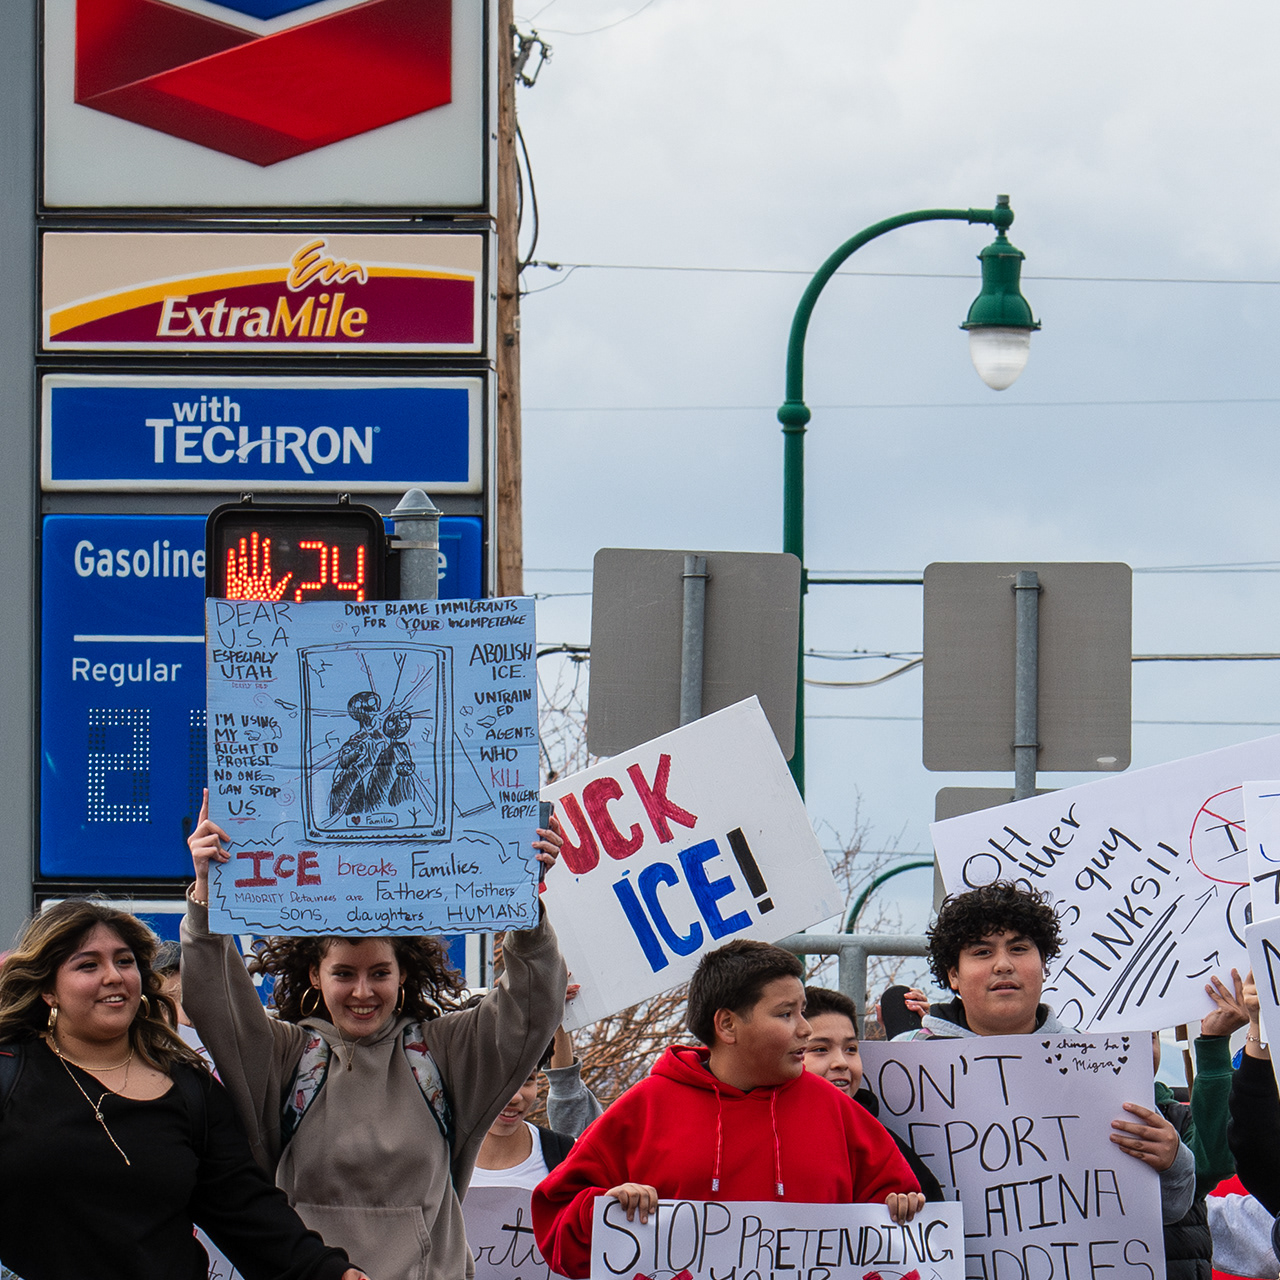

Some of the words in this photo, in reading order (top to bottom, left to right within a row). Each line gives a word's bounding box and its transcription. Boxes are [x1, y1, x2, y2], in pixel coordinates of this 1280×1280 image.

[289, 239, 368, 290] Em
[156, 293, 368, 338] ExtraMile
[172, 396, 240, 423] with
[74, 540, 206, 577] Gasoline
[295, 541, 364, 602] 24
[215, 602, 293, 627] DEAR
[345, 603, 378, 616] DONT
[385, 603, 429, 616] BLAME
[435, 600, 518, 614] IMMIGRANTS
[364, 617, 387, 628] FOR
[401, 618, 440, 630] YOUR
[217, 627, 290, 649] U.S.A
[469, 642, 532, 666] ABOLISH
[72, 658, 182, 687] Regular
[221, 665, 272, 680] UTAH
[492, 664, 526, 681] ICE.
[474, 688, 532, 705] UNTRAIN
[215, 713, 235, 727] I'M
[241, 715, 278, 728] USING
[496, 705, 514, 717] ED
[214, 728, 238, 742] MY
[215, 743, 259, 755] RIGHT
[264, 742, 278, 753] TO
[480, 746, 518, 763] WHO
[214, 770, 232, 782] NO
[238, 770, 262, 781] ONE
[491, 767, 525, 788] KILL
[218, 784, 241, 795] CAN
[249, 785, 281, 798] STOP
[365, 816, 394, 825] Familia
[555, 753, 698, 875] UCK
[963, 826, 1031, 888] OH
[1014, 803, 1080, 892] other
[234, 850, 321, 888] ICE
[337, 855, 397, 876] breaks
[411, 851, 482, 879] Families.
[235, 893, 283, 903] MAJORITY
[290, 891, 337, 903] Detainees
[376, 880, 448, 902] Fathers,
[455, 881, 515, 899] Mothers
[347, 906, 433, 928] daughters,
[447, 902, 530, 922] HUMANS.
[1041, 842, 1191, 1032] STINKS!!
[1072, 1057, 1114, 1073] Migra
[863, 1055, 1022, 1116] ON'T
[908, 1115, 1080, 1188] EPORT
[603, 1200, 731, 1274] STOP
[739, 1215, 953, 1270] PRETENDING
